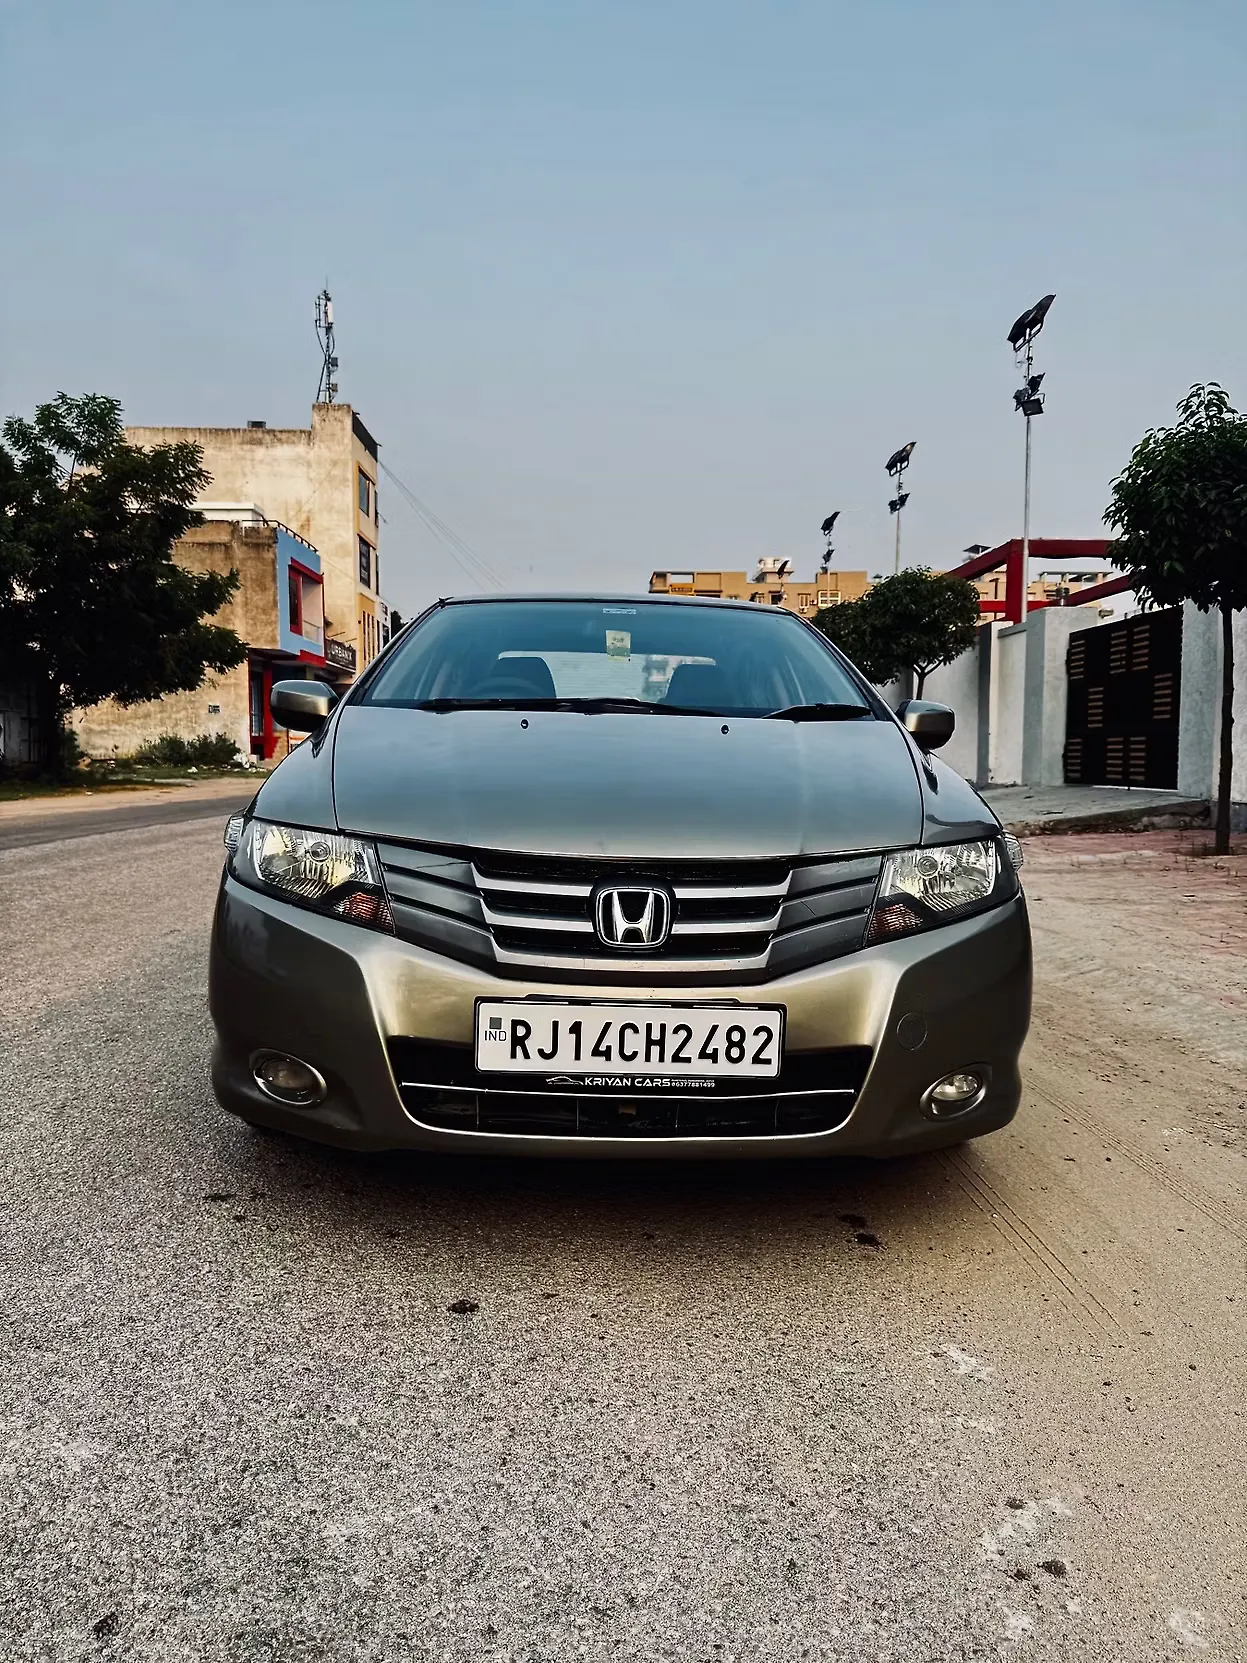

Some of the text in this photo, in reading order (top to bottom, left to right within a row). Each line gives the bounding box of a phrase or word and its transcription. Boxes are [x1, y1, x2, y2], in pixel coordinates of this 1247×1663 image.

[484, 1030, 507, 1042] IND
[510, 1018, 774, 1065] RJ14CH2482
[584, 1077, 671, 1087] KRIYAN CARS
